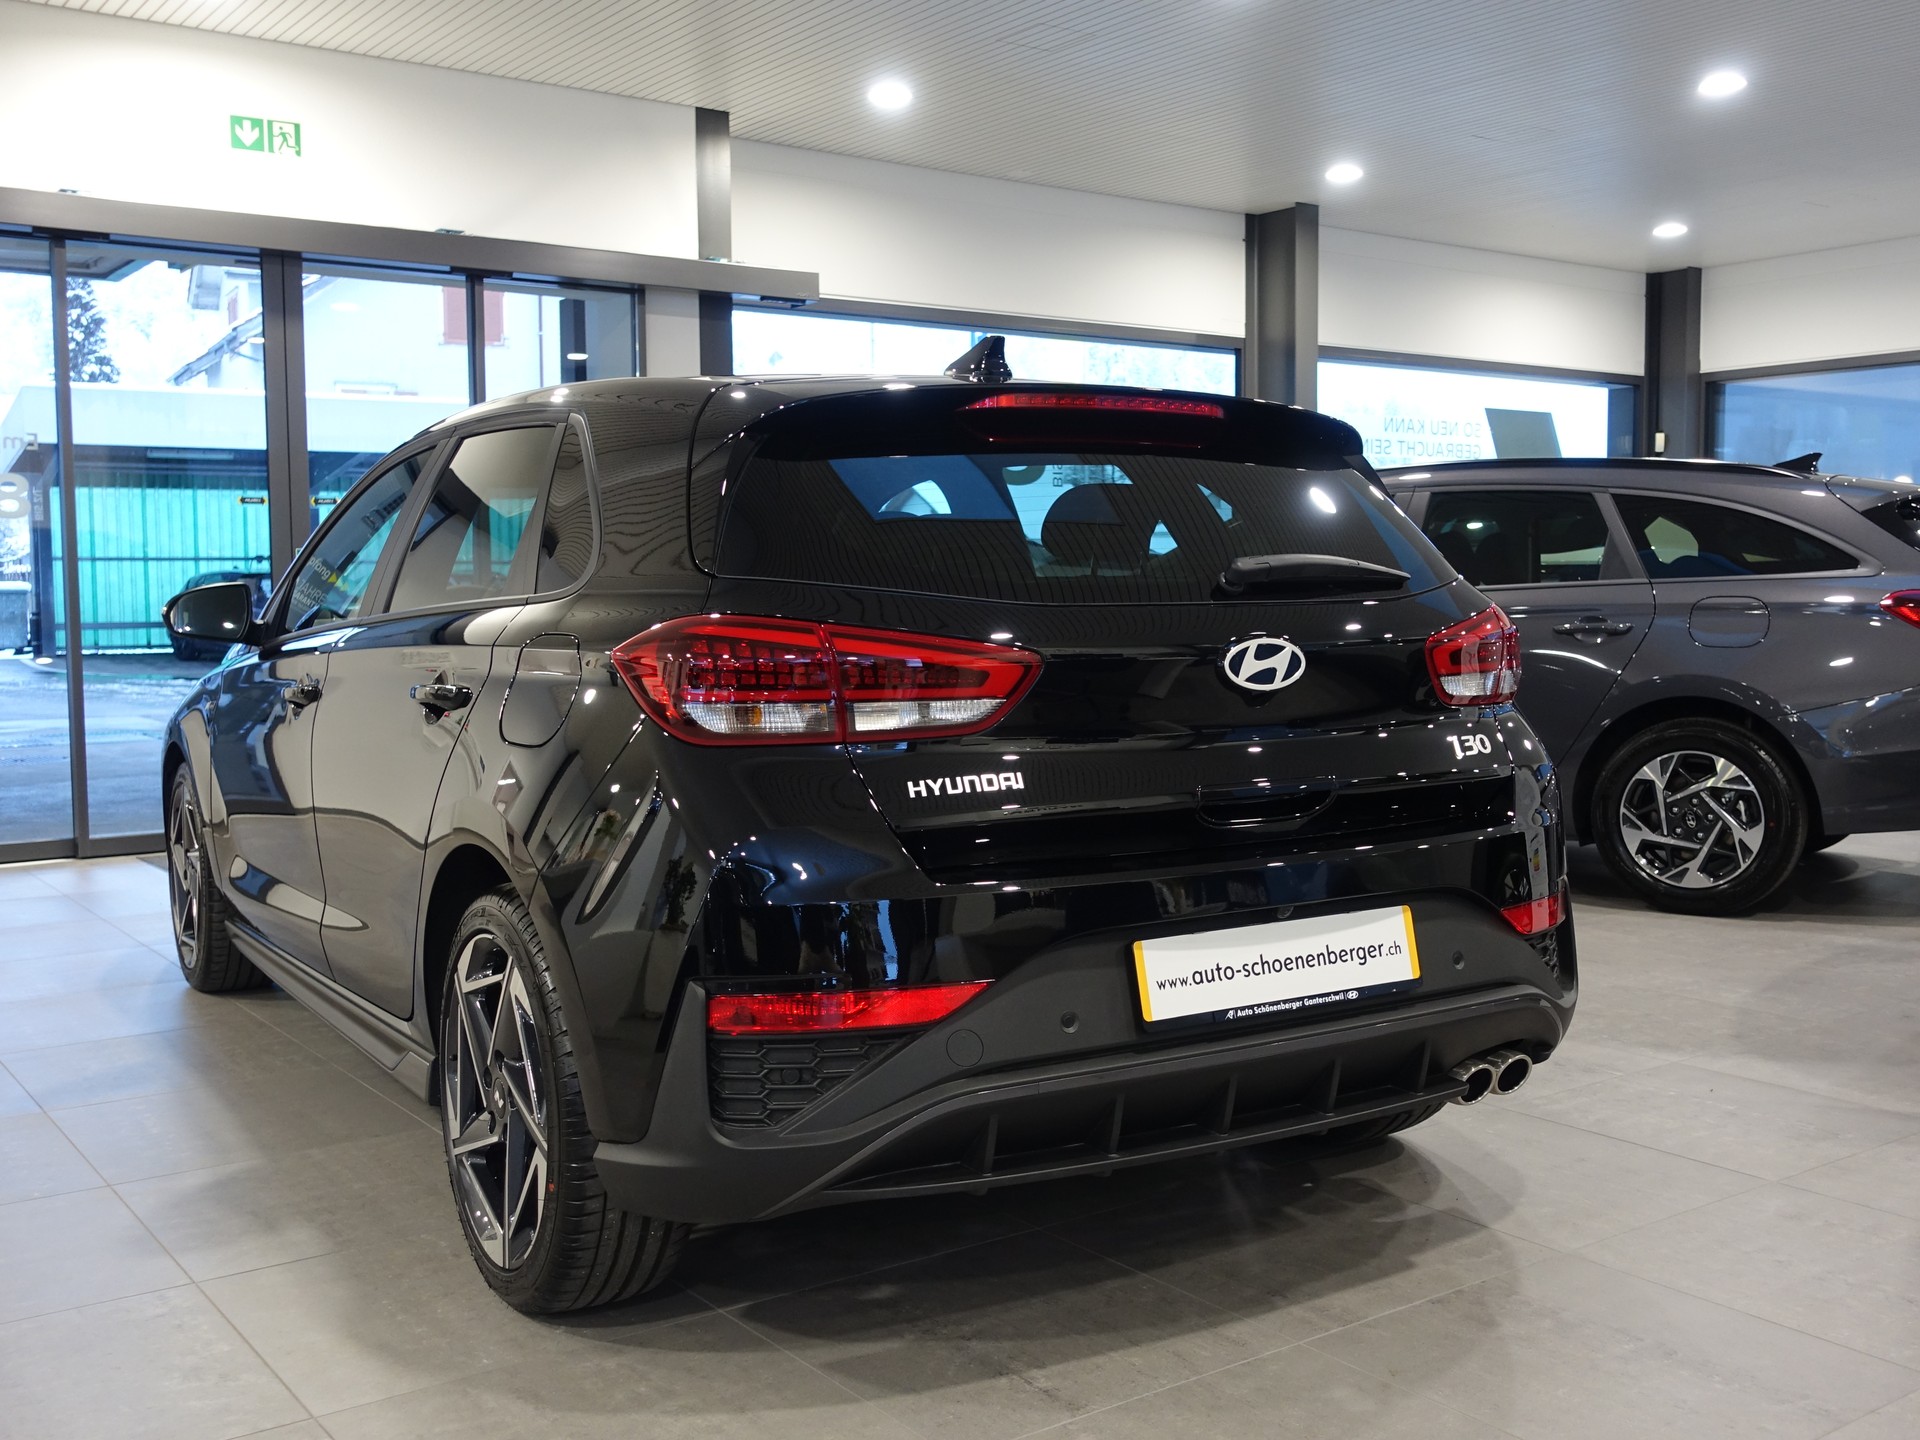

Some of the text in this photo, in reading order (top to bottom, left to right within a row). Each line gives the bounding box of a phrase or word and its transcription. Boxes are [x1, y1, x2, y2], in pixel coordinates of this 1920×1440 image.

[907, 772, 1025, 798] HYUNDAI
[1156, 941, 1402, 991] www.auto-schoenenberger.ch
[1237, 1008, 1253, 1018] Auto
[1254, 1000, 1303, 1014] Schönenberger
[1304, 992, 1344, 1006] Ganterschwil
